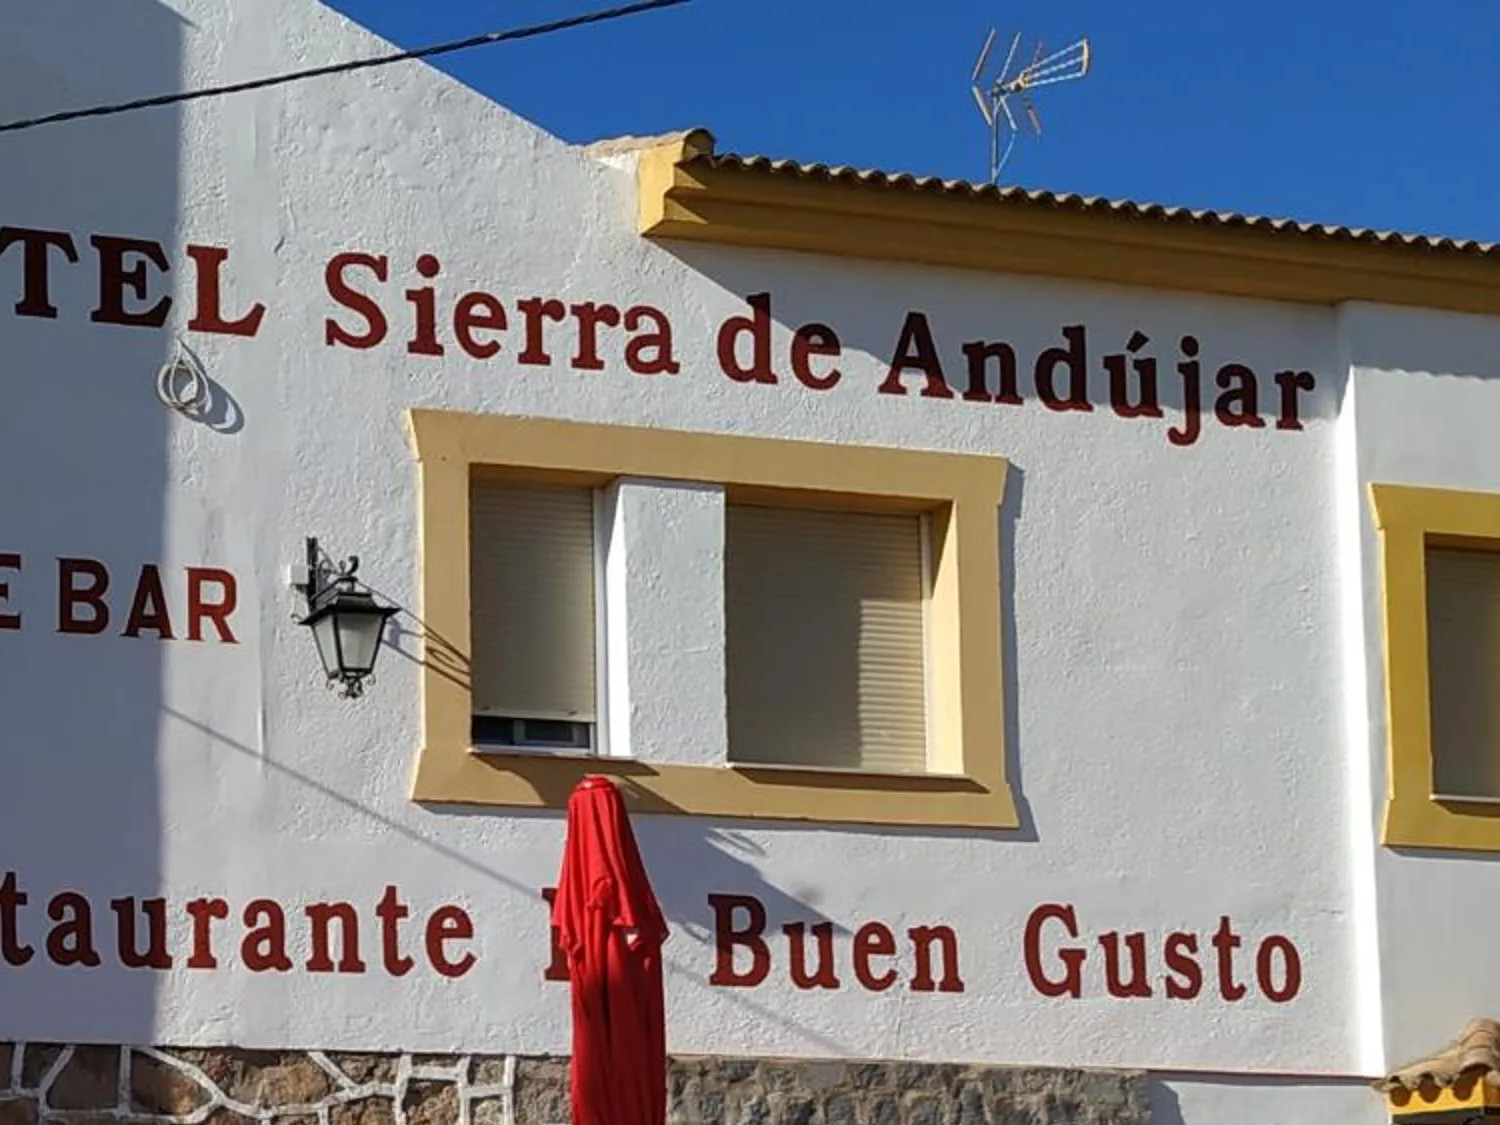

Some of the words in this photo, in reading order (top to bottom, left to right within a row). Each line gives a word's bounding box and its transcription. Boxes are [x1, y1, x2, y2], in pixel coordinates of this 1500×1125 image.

[324, 252, 681, 375] Sierra
[717, 291, 842, 391] de
[878, 310, 1315, 446] Andújar
[55, 557, 240, 645] BAR
[707, 893, 966, 994] Buen
[1022, 903, 1302, 1003] Gusto
